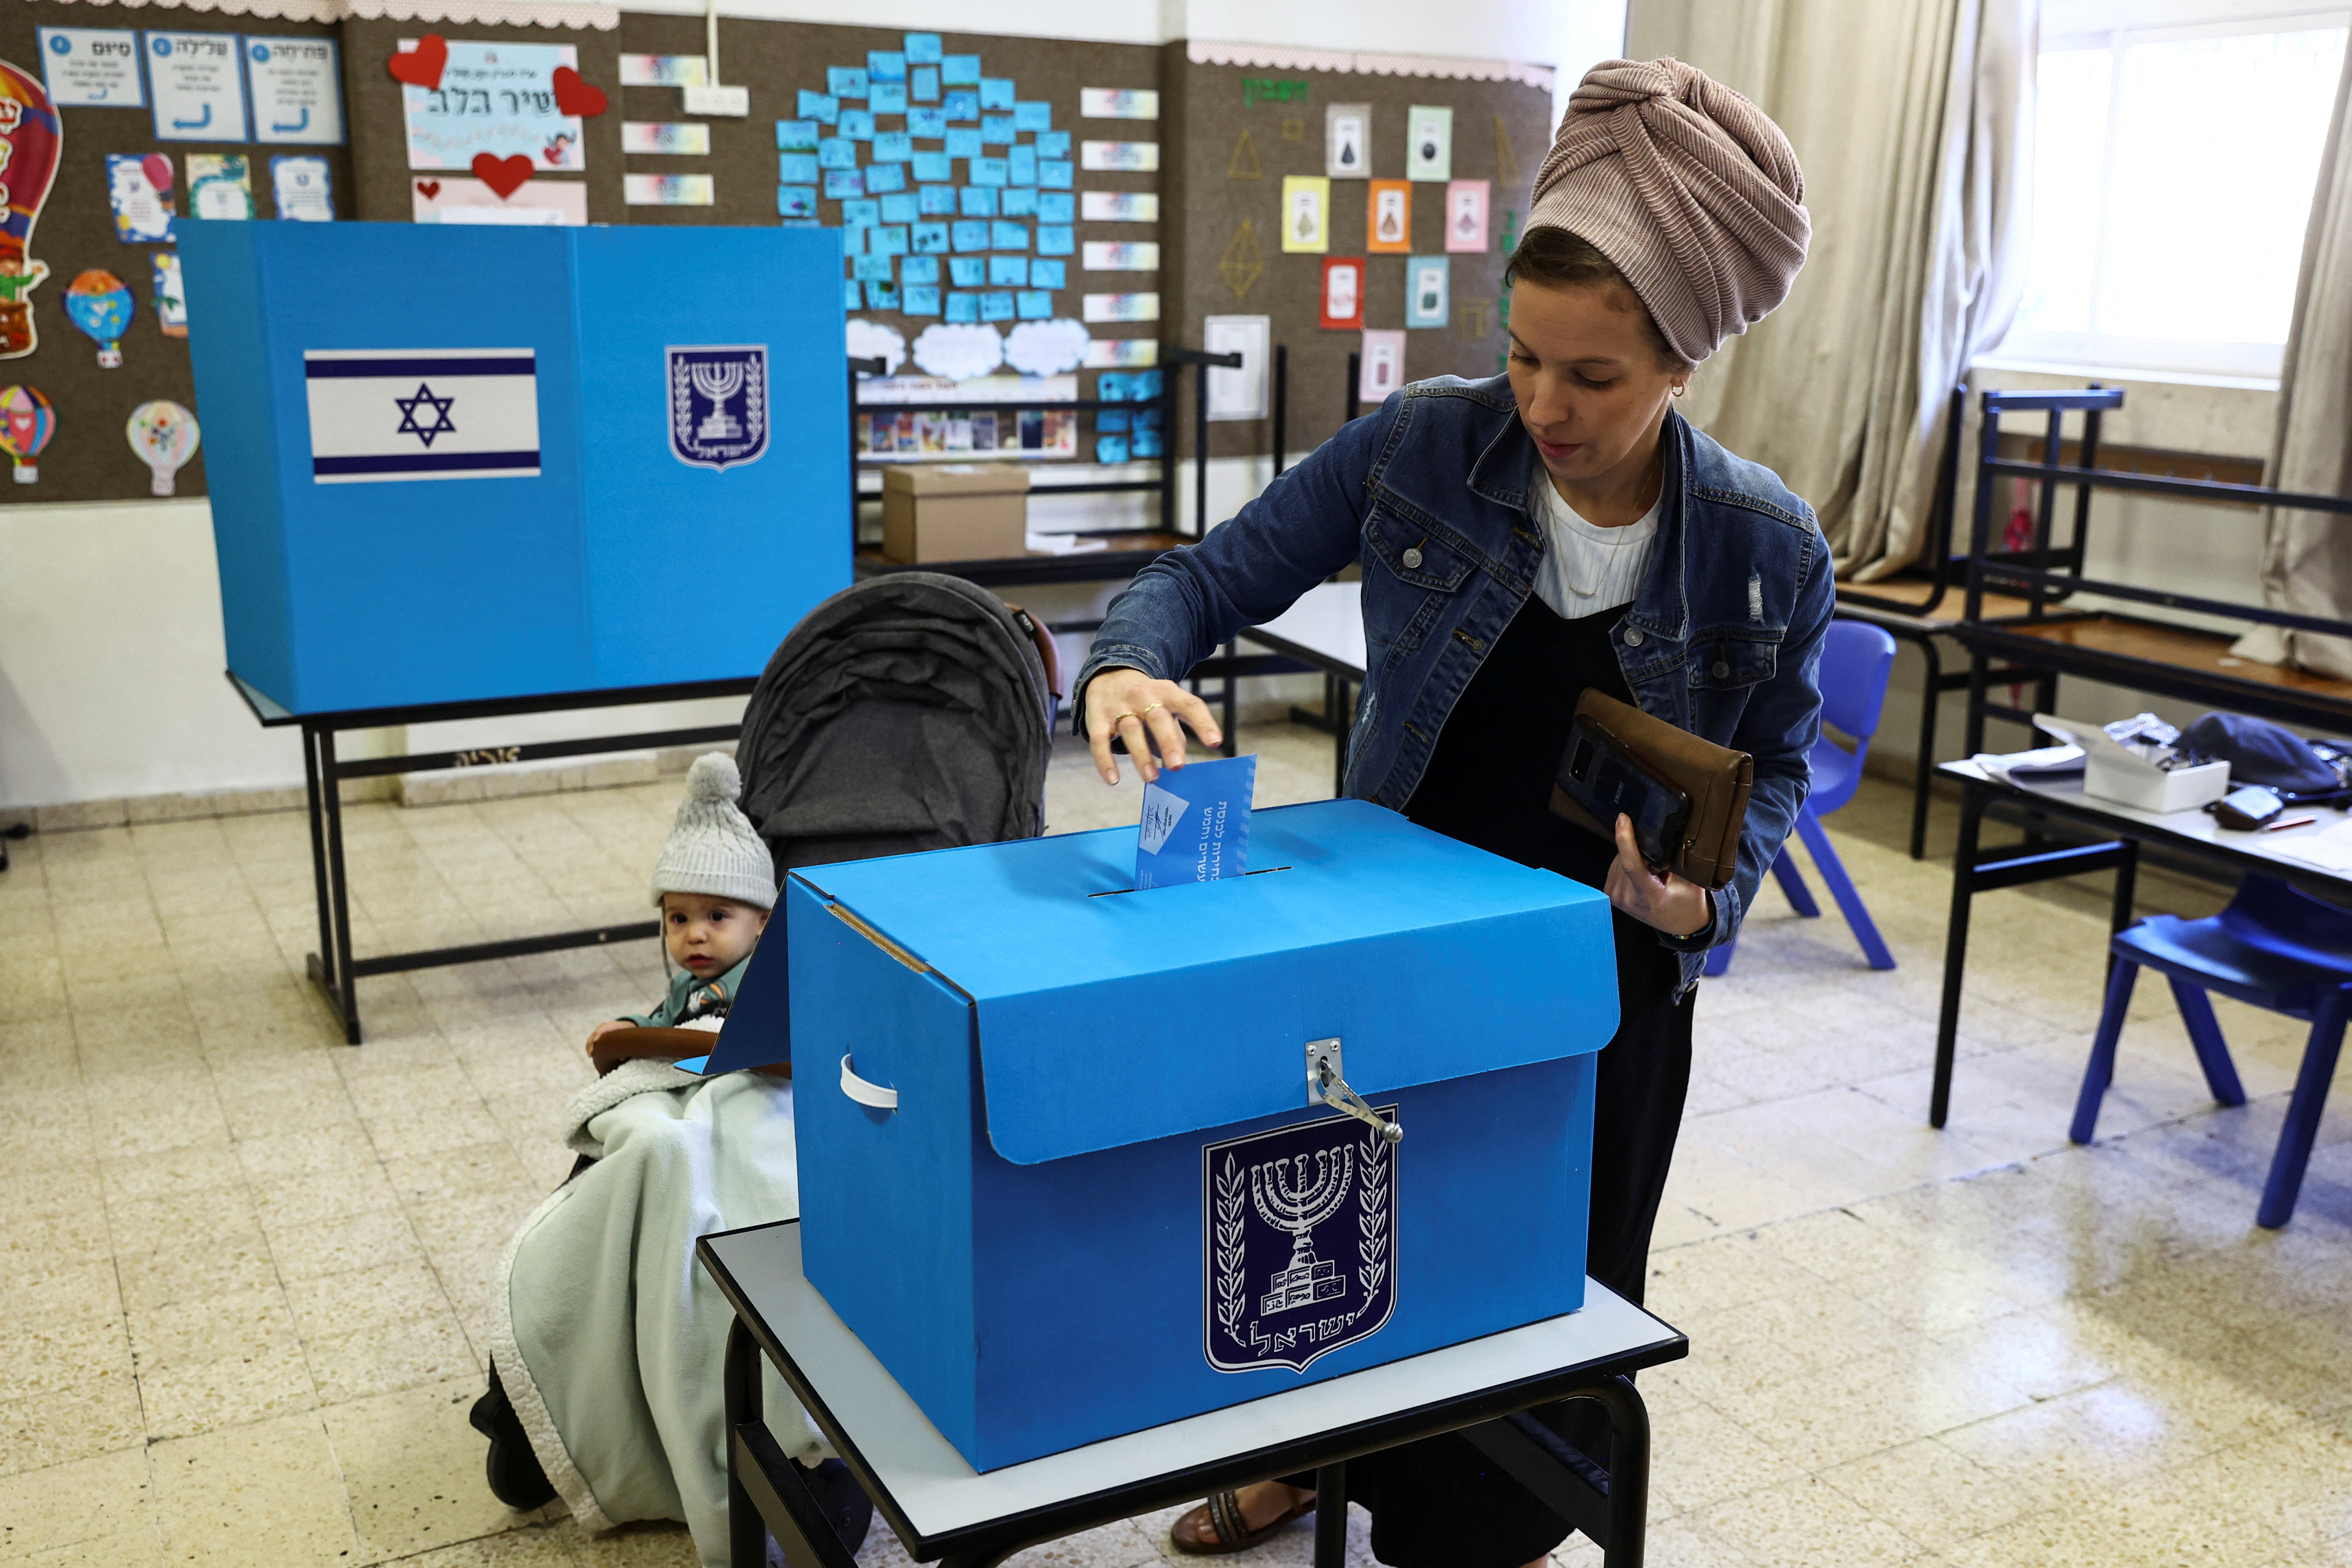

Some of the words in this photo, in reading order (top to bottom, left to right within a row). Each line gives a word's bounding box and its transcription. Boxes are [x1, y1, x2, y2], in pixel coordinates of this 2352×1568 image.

[427, 86, 491, 115] בלב
[1200, 807, 1213, 840] וחמש
[1212, 801, 1227, 838] לכנסת
[1197, 843, 1208, 882] עשרים
[1250, 1312, 1355, 1357] ישראל
